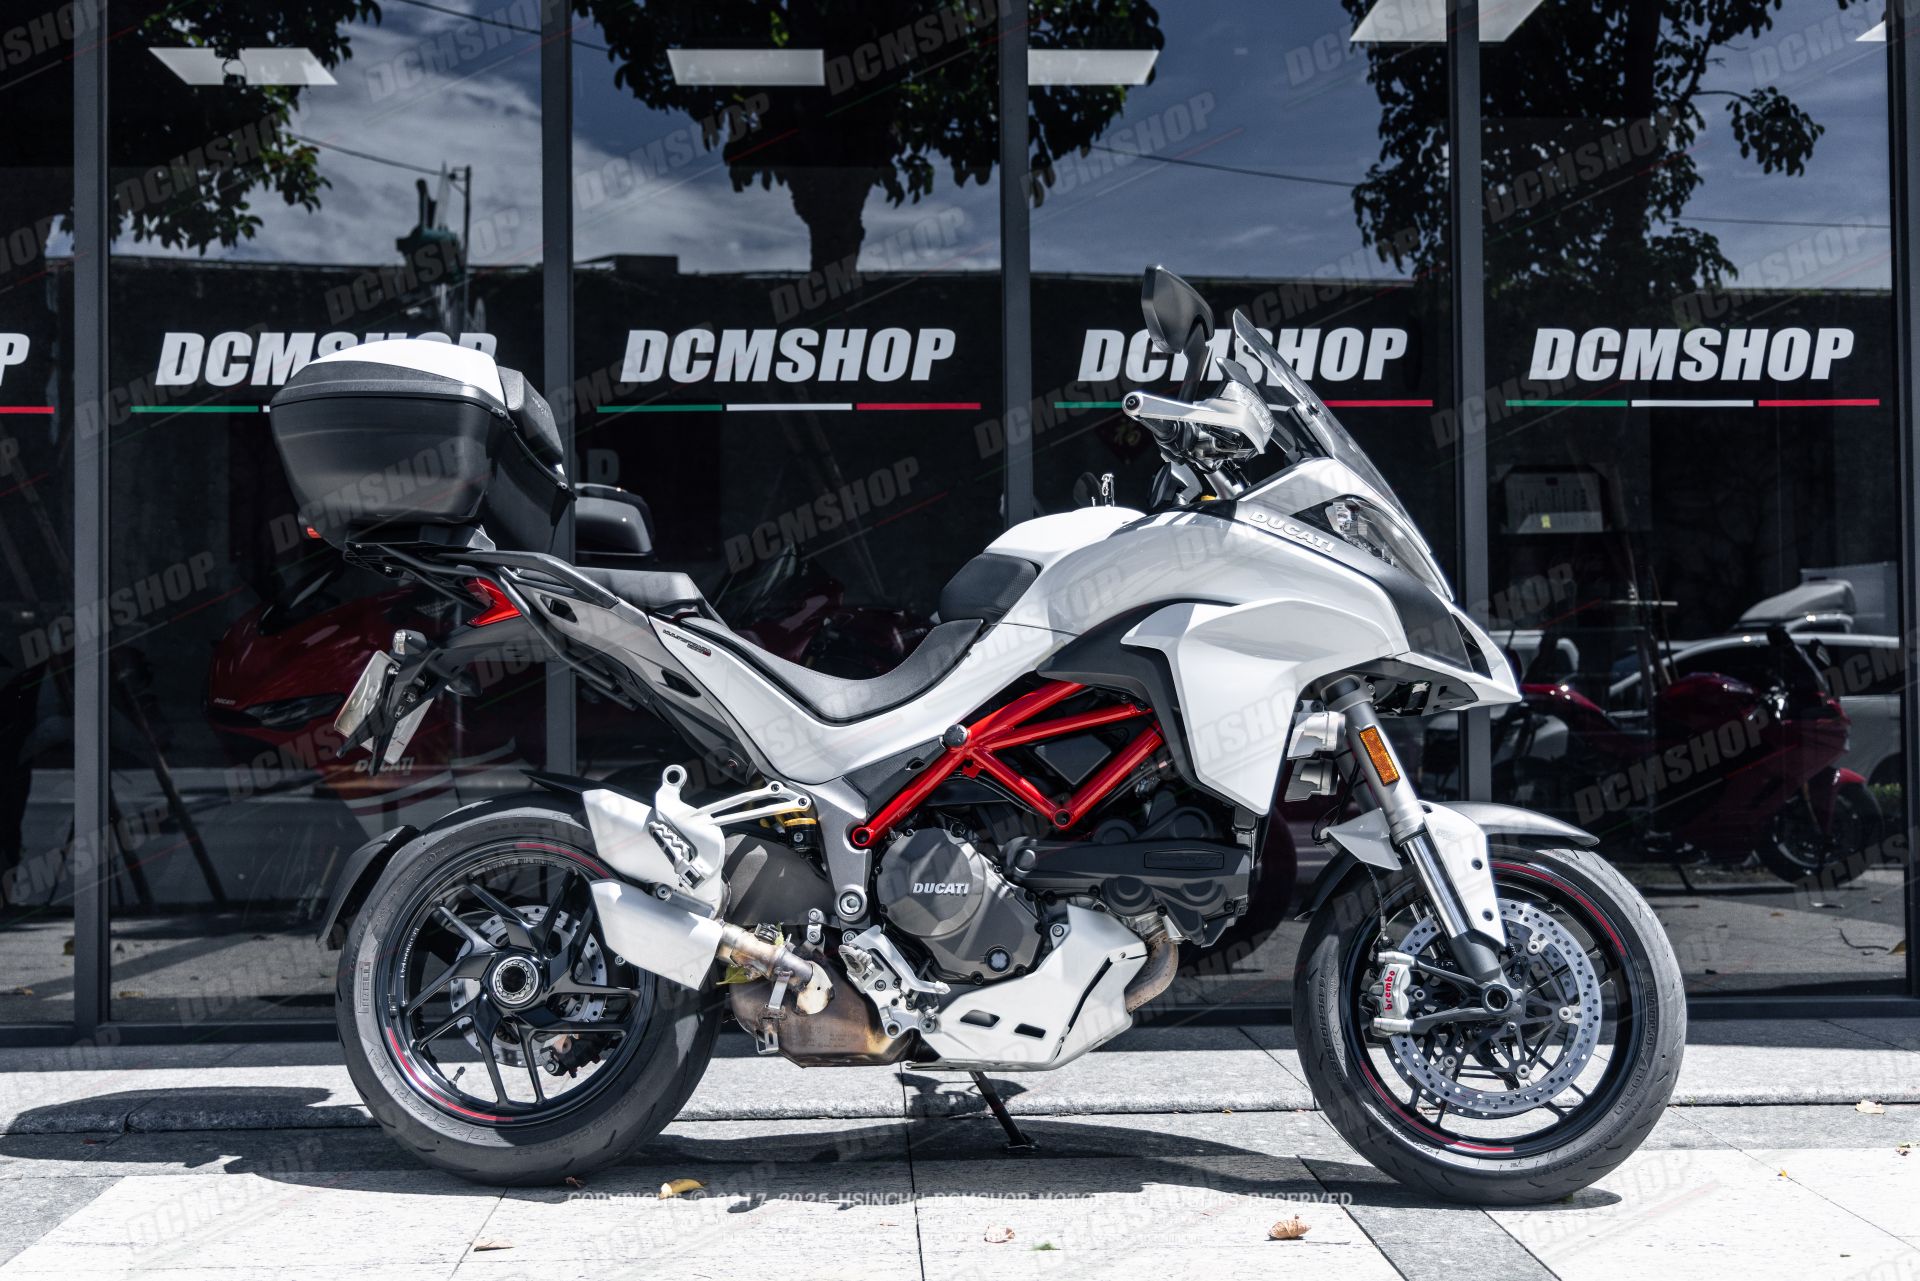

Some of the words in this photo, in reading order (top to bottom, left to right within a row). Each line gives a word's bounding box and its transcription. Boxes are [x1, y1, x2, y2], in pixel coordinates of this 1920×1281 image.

[620, 327, 956, 383] DCMSHOP
[1528, 327, 1855, 382] DCMSHOP
[1249, 511, 1335, 553] DUCATI
[912, 882, 970, 895] DUCATI
[1384, 970, 1396, 1010] brembo
